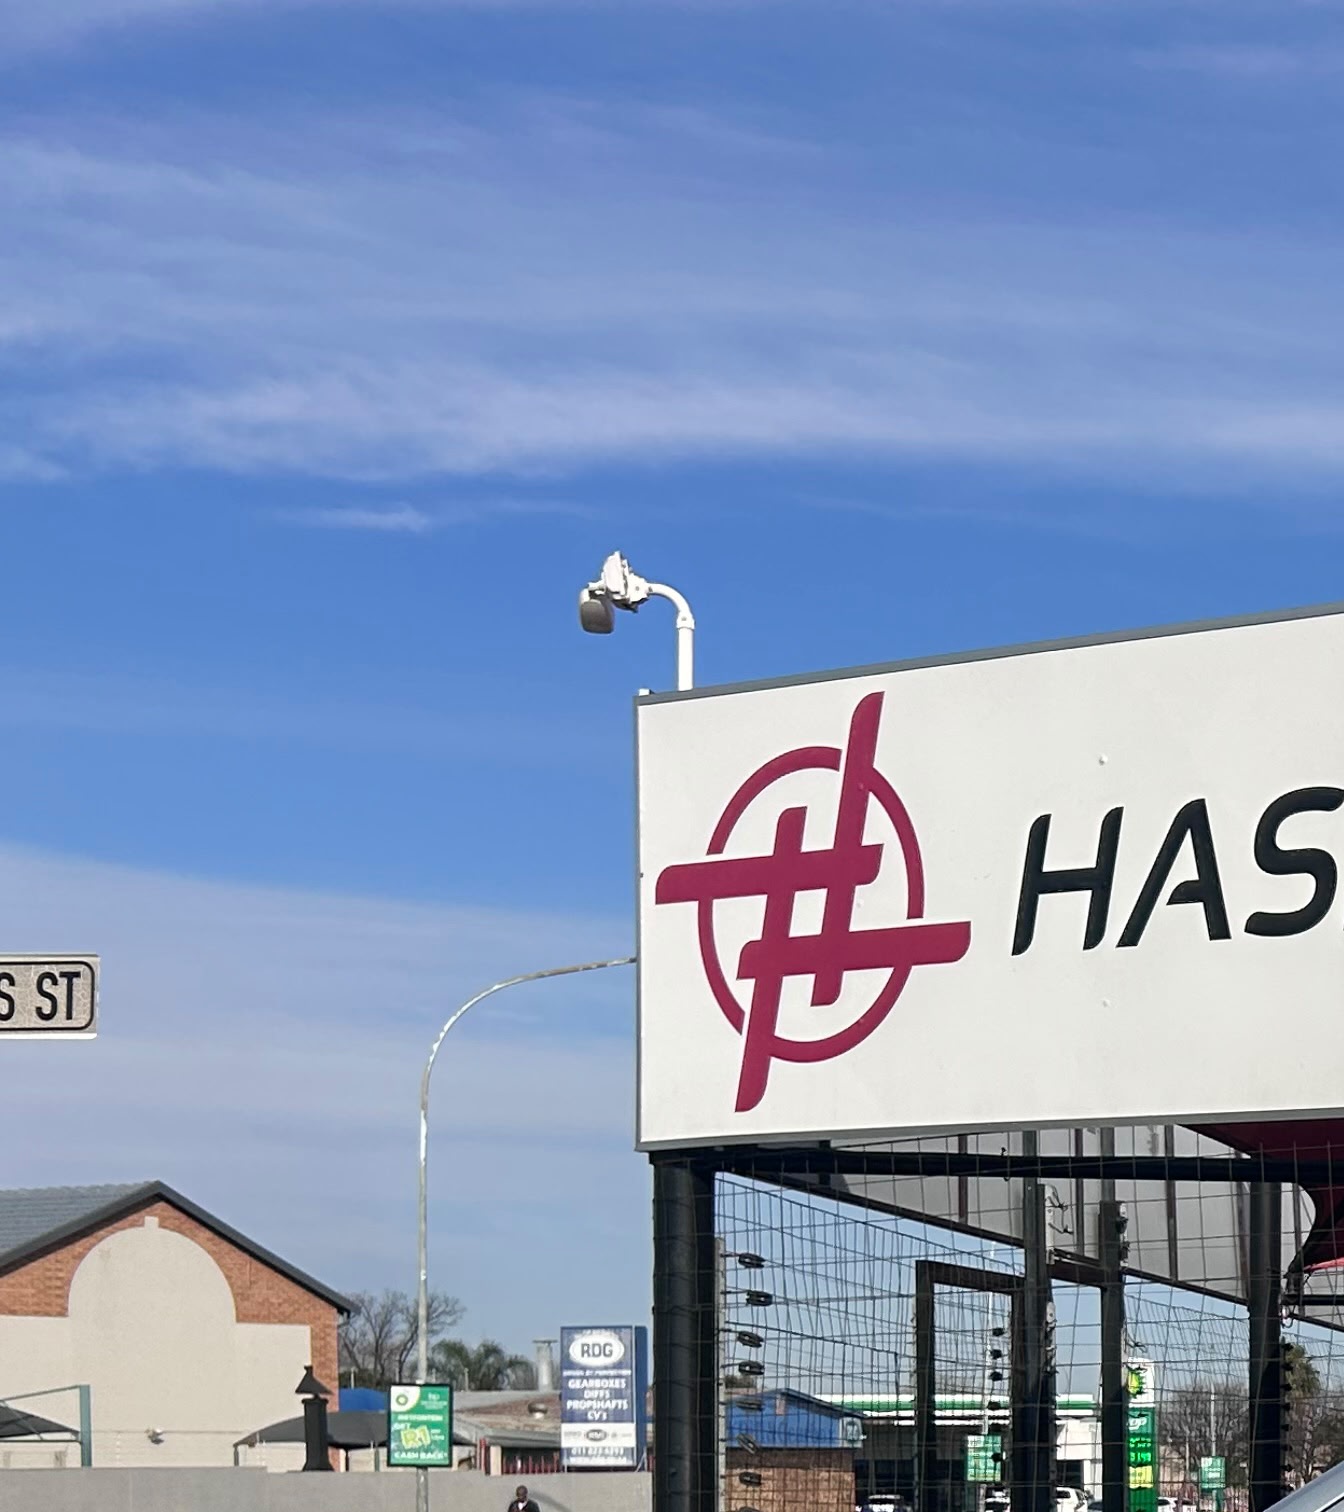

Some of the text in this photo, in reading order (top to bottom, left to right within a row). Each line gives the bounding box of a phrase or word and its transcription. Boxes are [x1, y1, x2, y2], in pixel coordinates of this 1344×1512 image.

[35, 971, 81, 1021] ST
[581, 1342, 613, 1358] RDG
[568, 1378, 626, 1389] GEARBOXES
[583, 1389, 610, 1399] DIFFS
[566, 1399, 628, 1410] PROPSHAFTS
